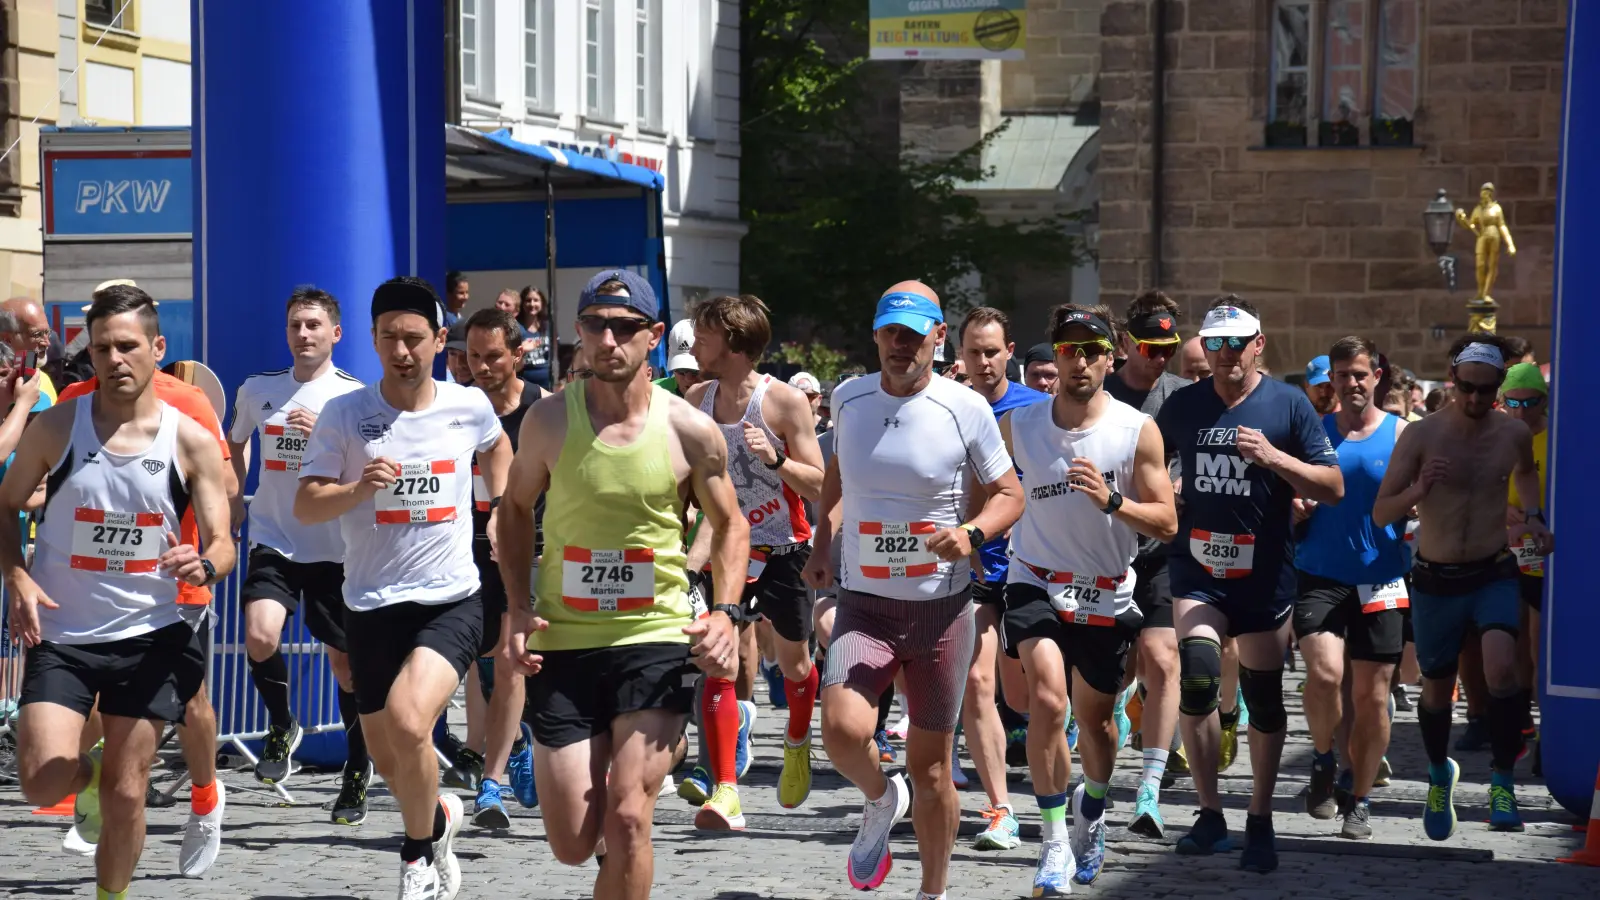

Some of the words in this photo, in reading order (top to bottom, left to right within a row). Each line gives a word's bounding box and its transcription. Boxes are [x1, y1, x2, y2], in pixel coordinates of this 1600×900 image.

[908, 1, 942, 12] GEGEN
[904, 20, 941, 29] BAYERN
[876, 31, 909, 43] ZEIGT
[912, 30, 969, 44] HALTUNG
[76, 180, 171, 214] PKW
[1197, 427, 1260, 446] TEA
[1196, 452, 1252, 479] MY
[393, 476, 440, 496] 2720
[1194, 475, 1251, 496] GYM
[401, 499, 434, 507] Thomas
[92, 525, 143, 546] 2773
[98, 547, 135, 557] Andreas
[874, 536, 919, 553] 2822
[1202, 542, 1239, 559] 2830
[888, 556, 907, 564] Andi
[1205, 558, 1235, 568] Siegfried
[581, 565, 634, 583] 2746
[590, 587, 625, 595] Martina
[1063, 584, 1101, 604] 2742
